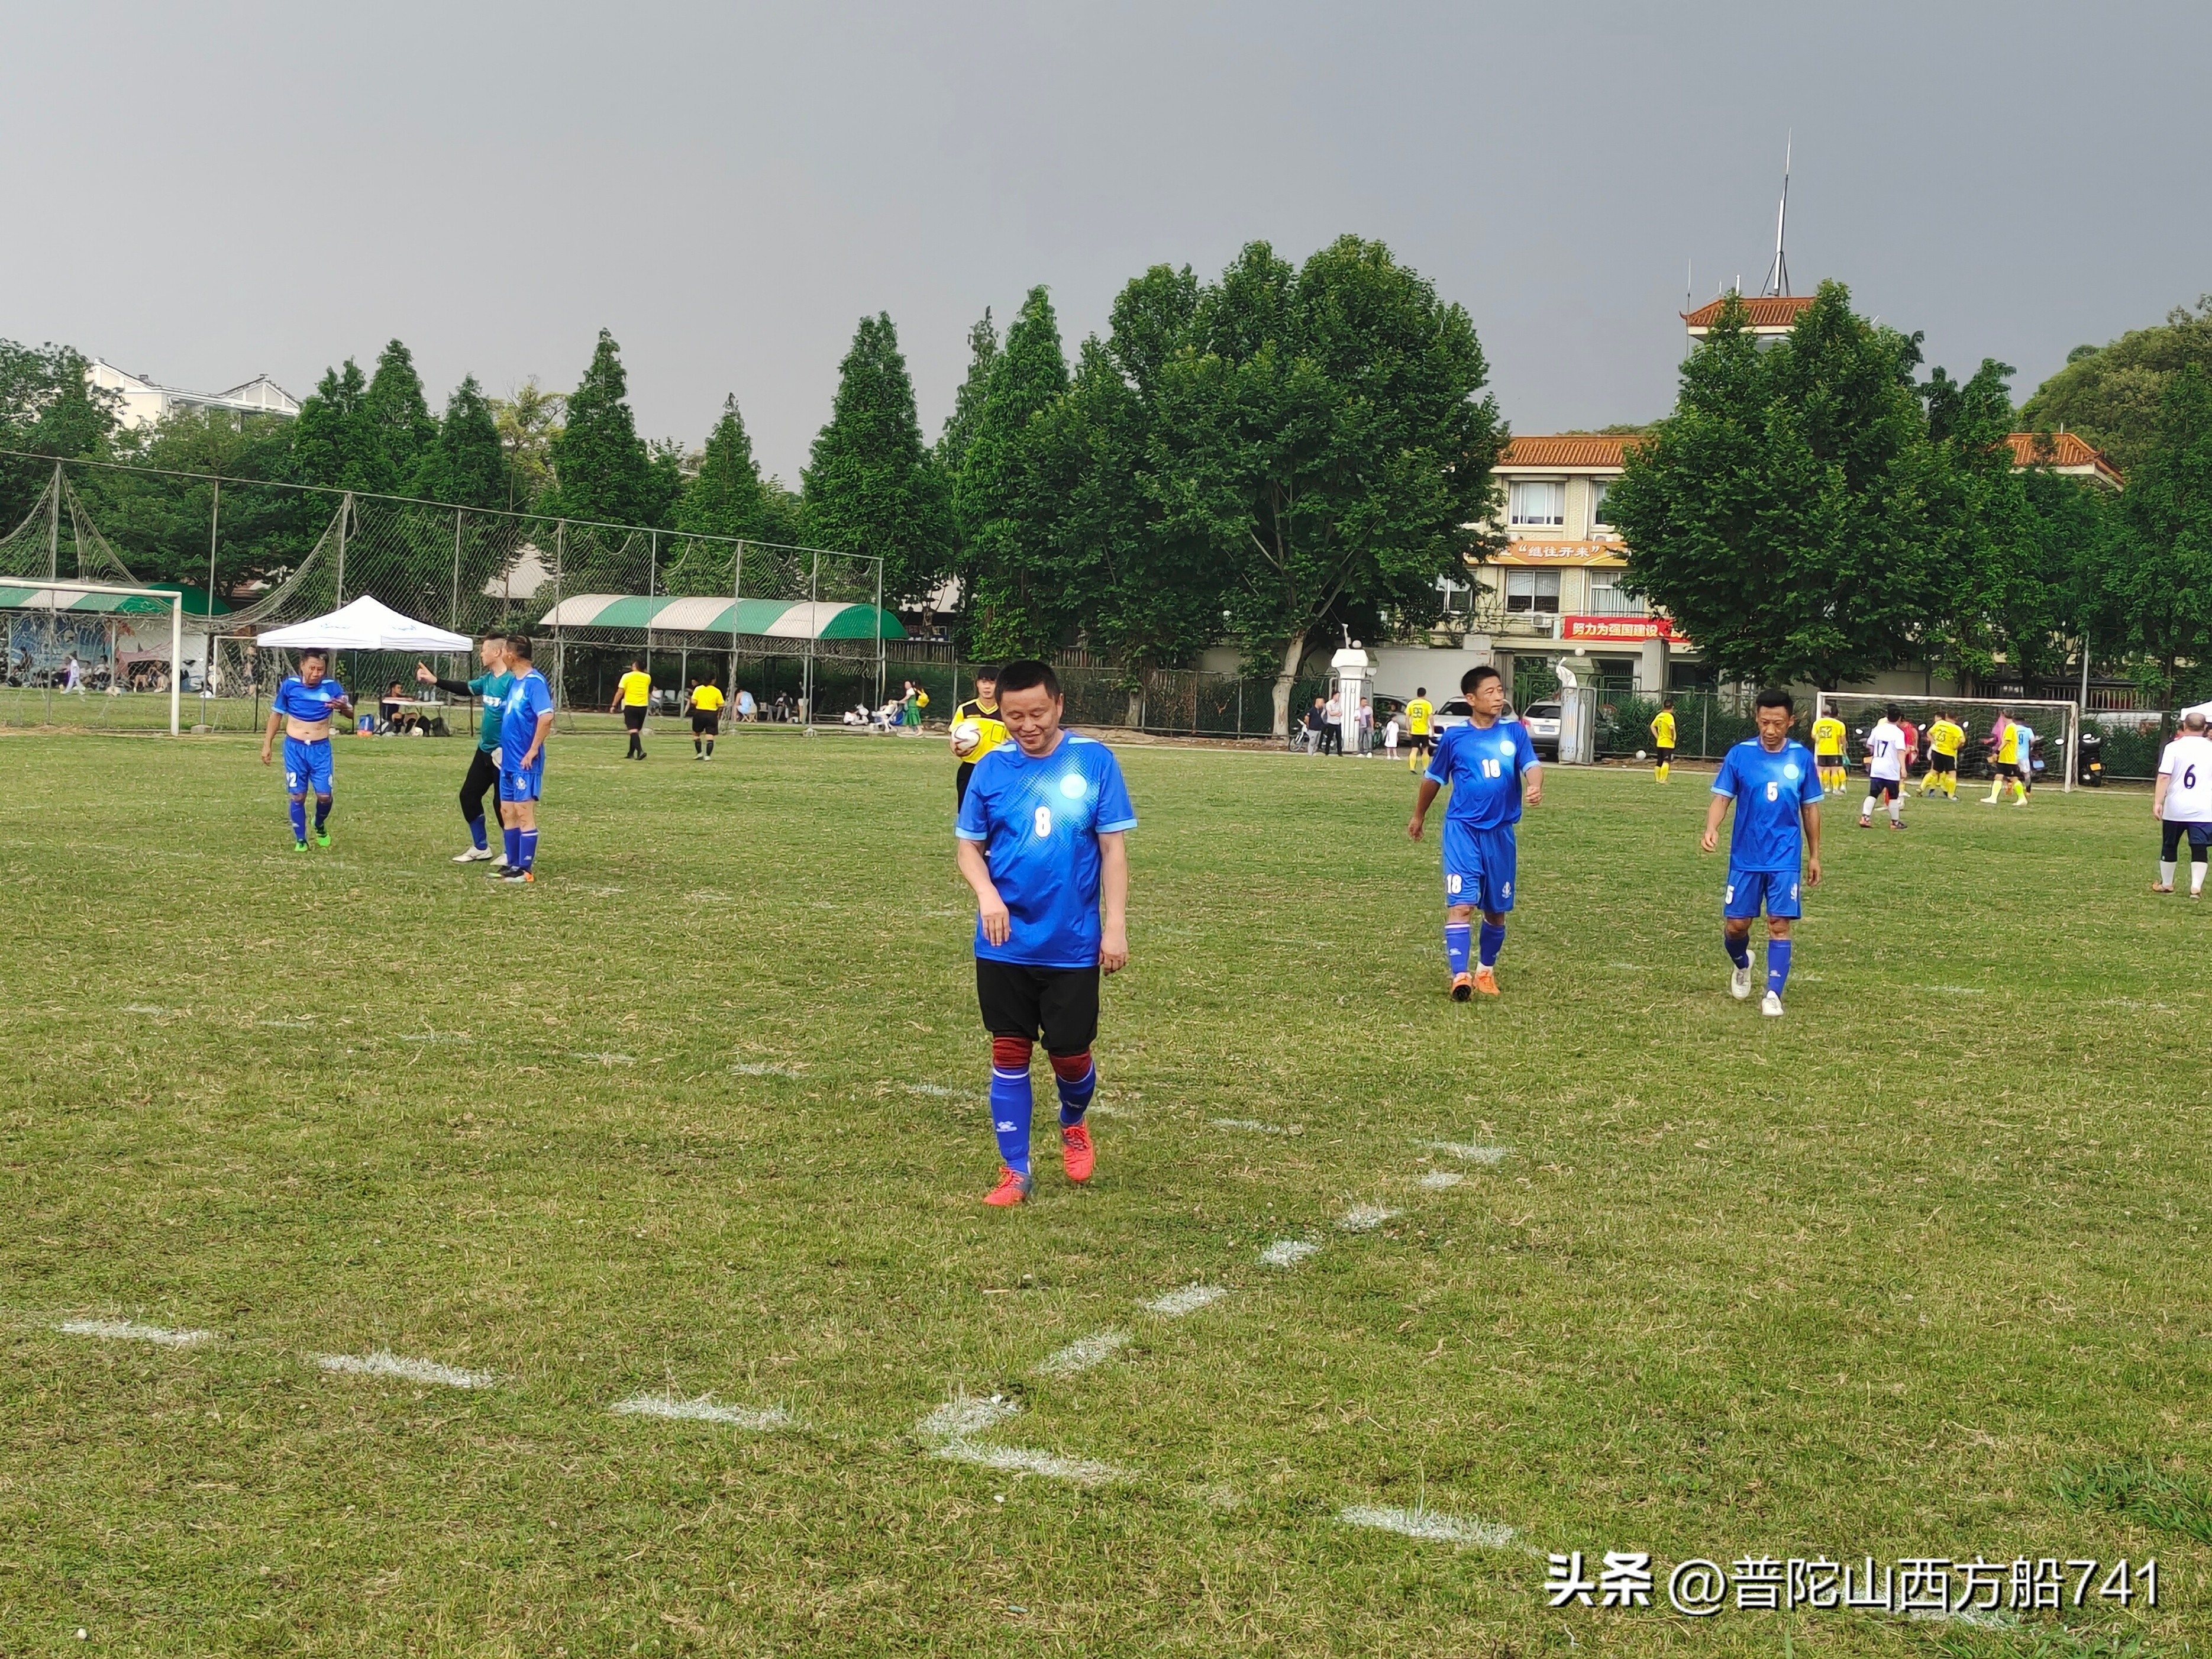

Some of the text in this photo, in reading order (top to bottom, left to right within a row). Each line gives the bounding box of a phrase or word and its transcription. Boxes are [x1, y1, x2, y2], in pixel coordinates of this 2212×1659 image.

[1877, 740, 1889, 758] 17
[1481, 758, 1501, 779] 18
[2184, 763, 2197, 790] 6
[1767, 781, 1778, 802] 5
[1034, 805, 1052, 838] 8
[1446, 873, 1462, 895] 18
[1725, 884, 1735, 905] 5
